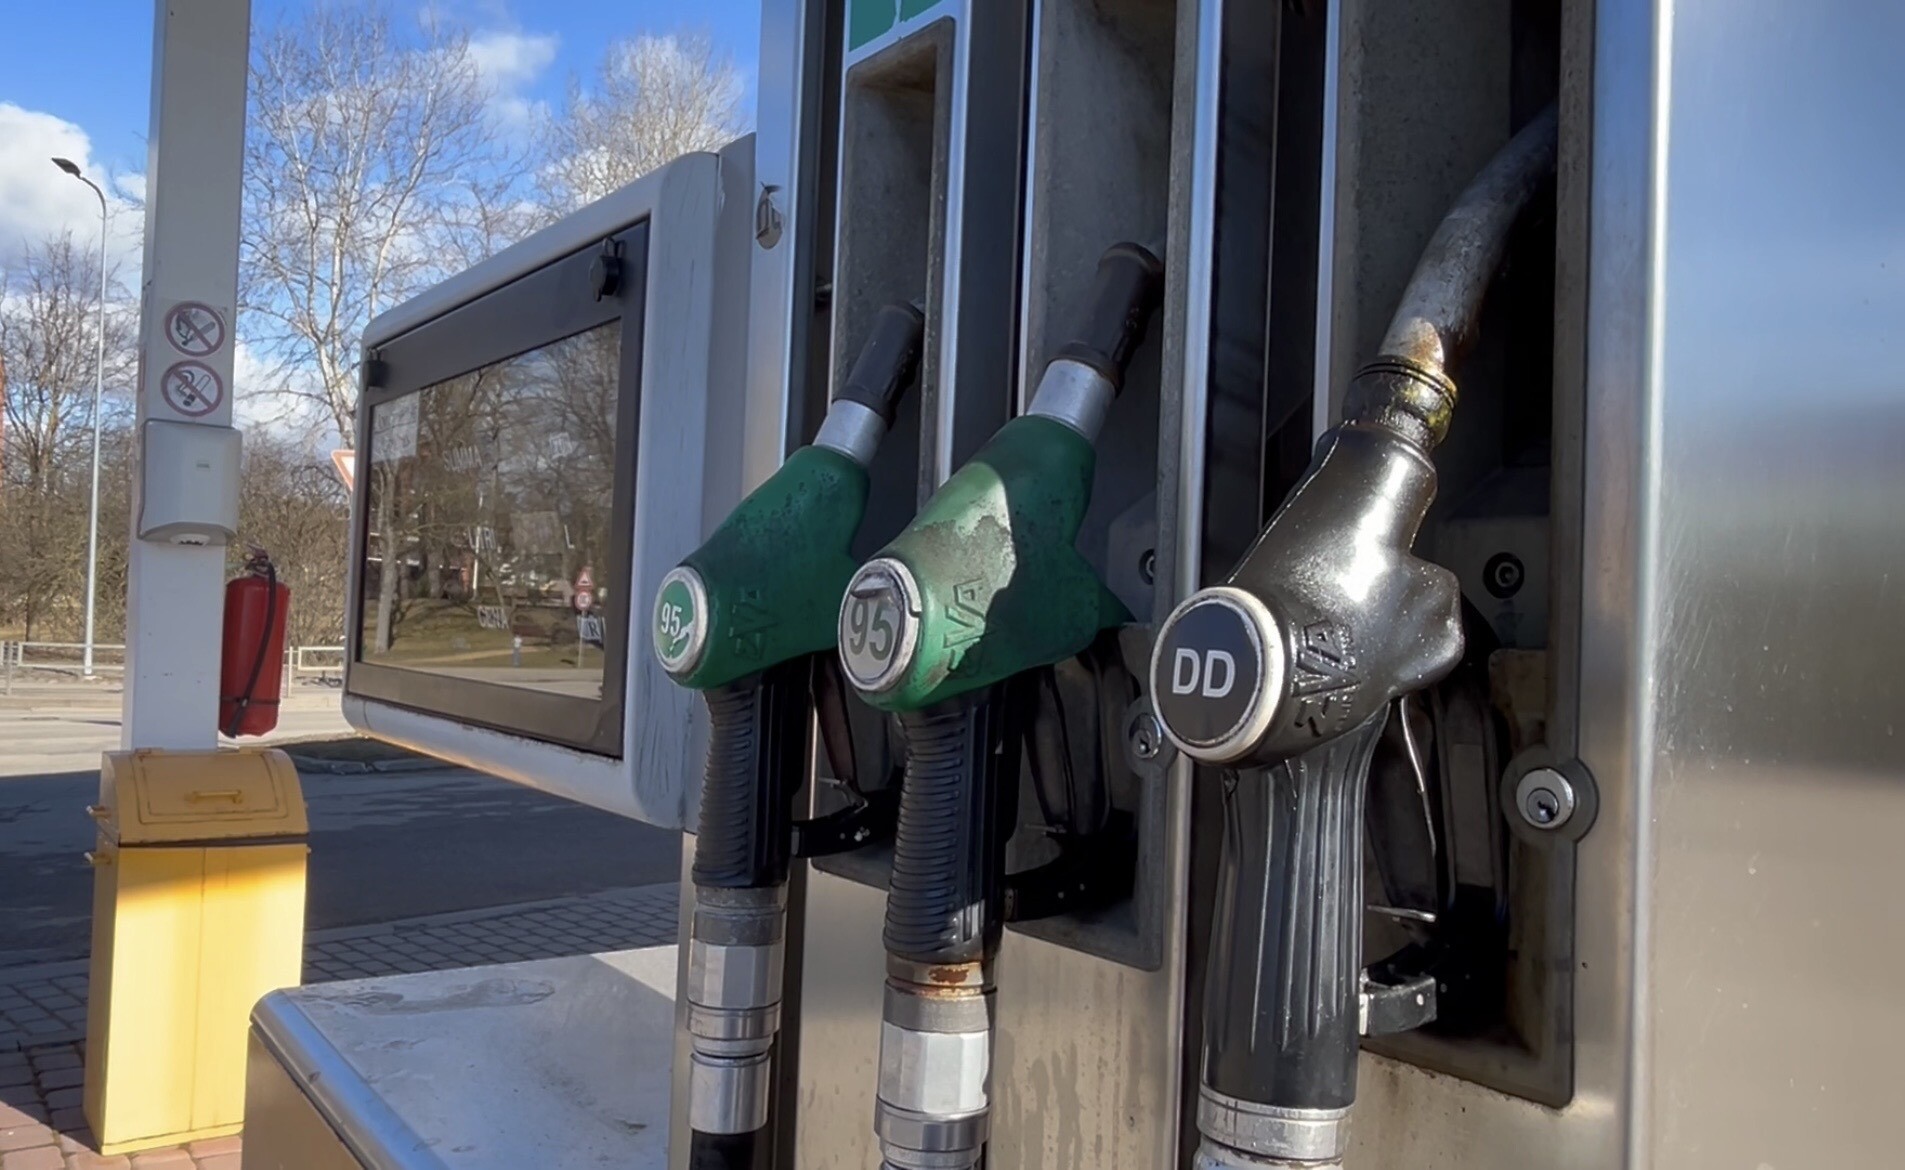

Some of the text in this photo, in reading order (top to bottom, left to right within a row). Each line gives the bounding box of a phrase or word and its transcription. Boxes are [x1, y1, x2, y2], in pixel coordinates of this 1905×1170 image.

[661, 602, 682, 637] 95
[849, 599, 893, 661] 95
[1172, 647, 1236, 698] DD
